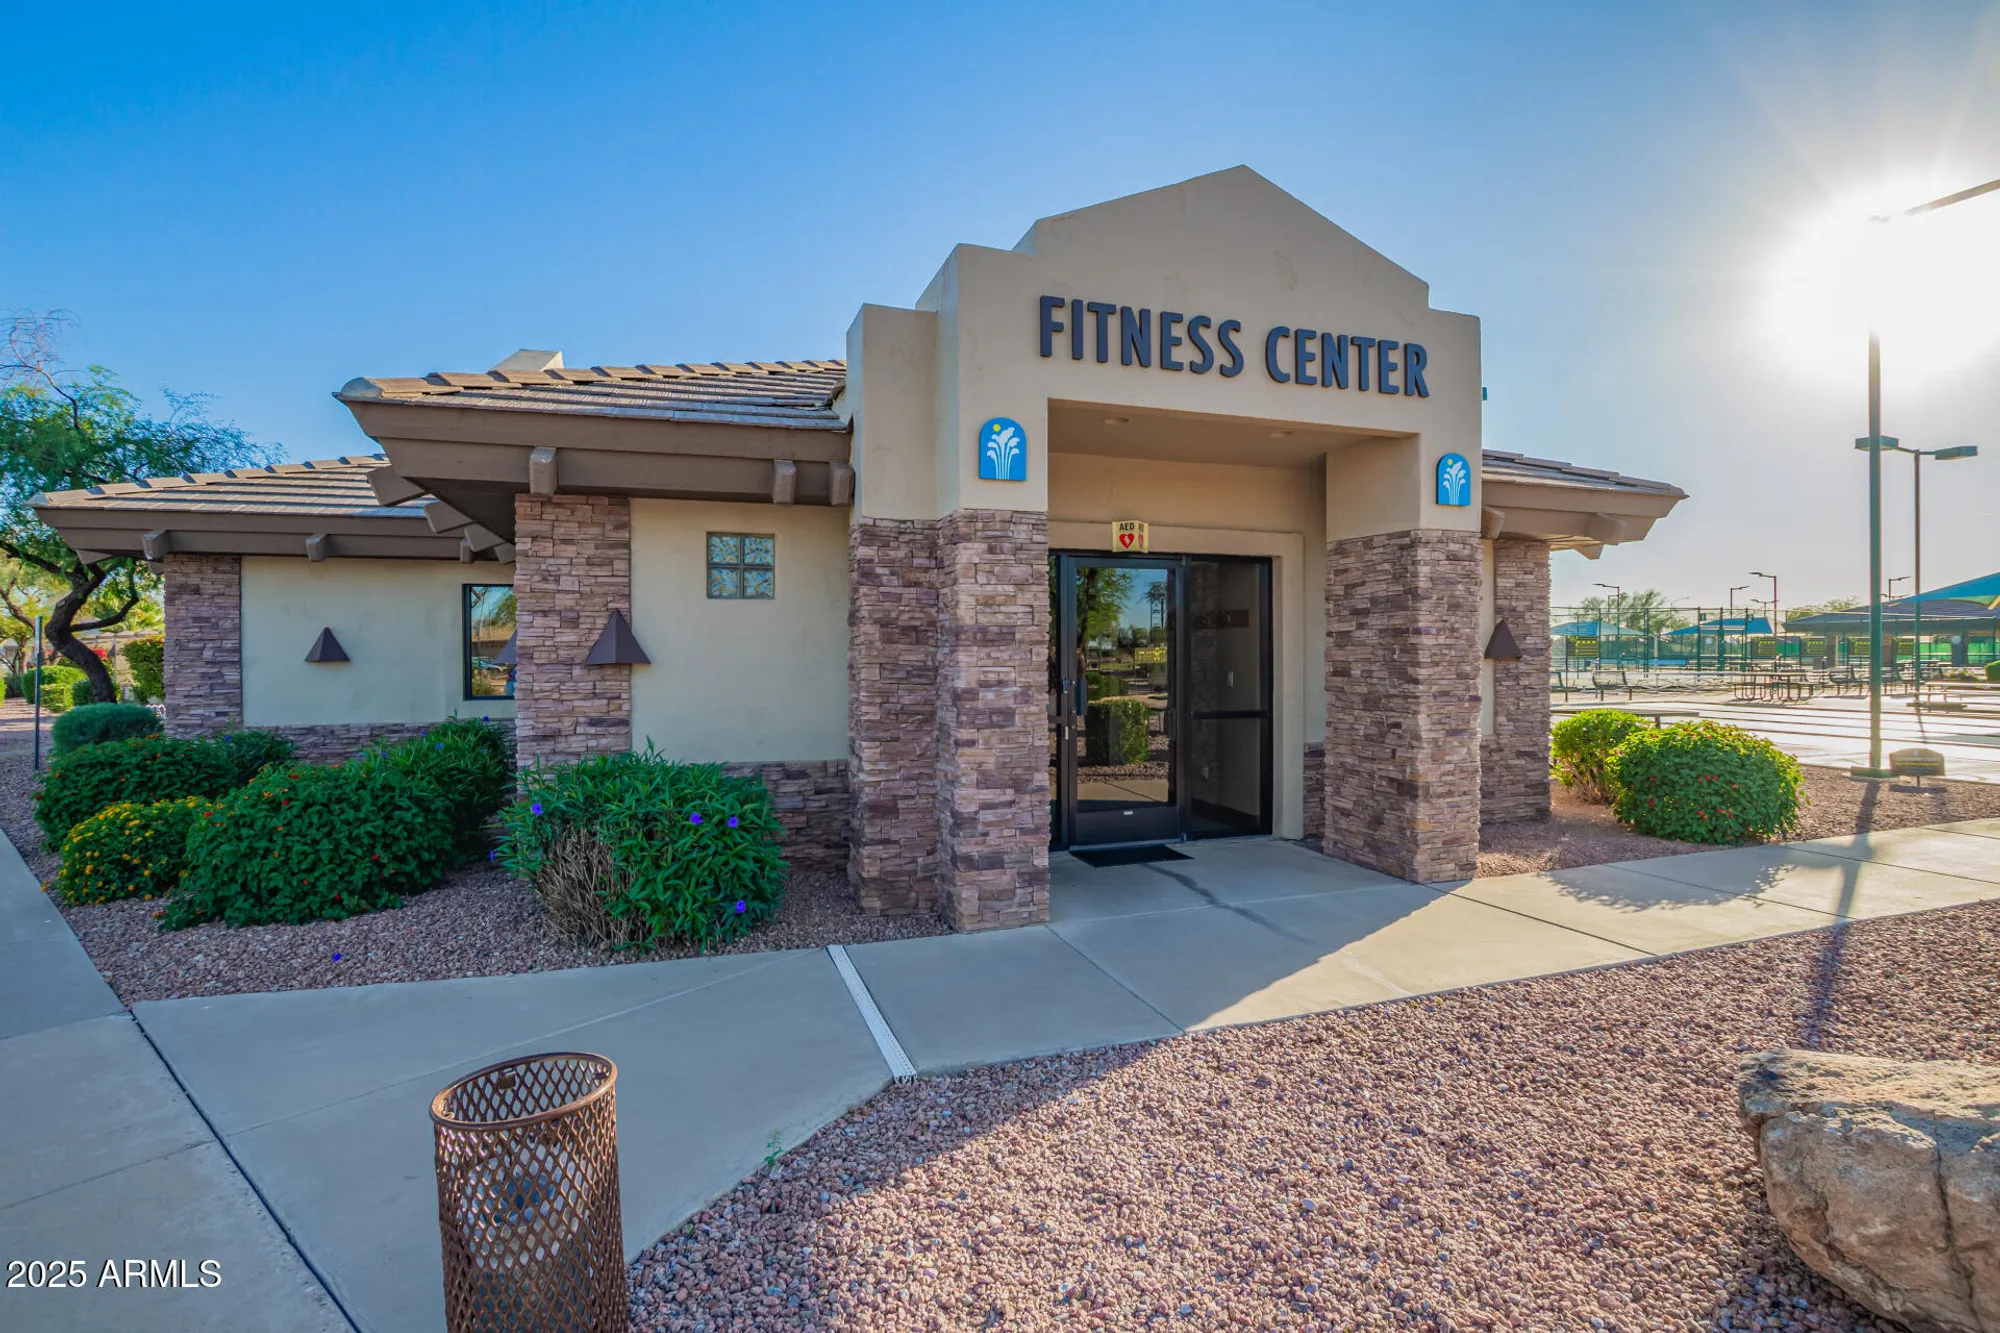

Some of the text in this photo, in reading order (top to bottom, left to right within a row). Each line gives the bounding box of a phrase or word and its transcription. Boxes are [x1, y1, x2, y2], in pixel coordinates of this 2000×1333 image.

[1040, 295, 1429, 398] FITNESS CENTER
[1119, 522, 1135, 531] AED
